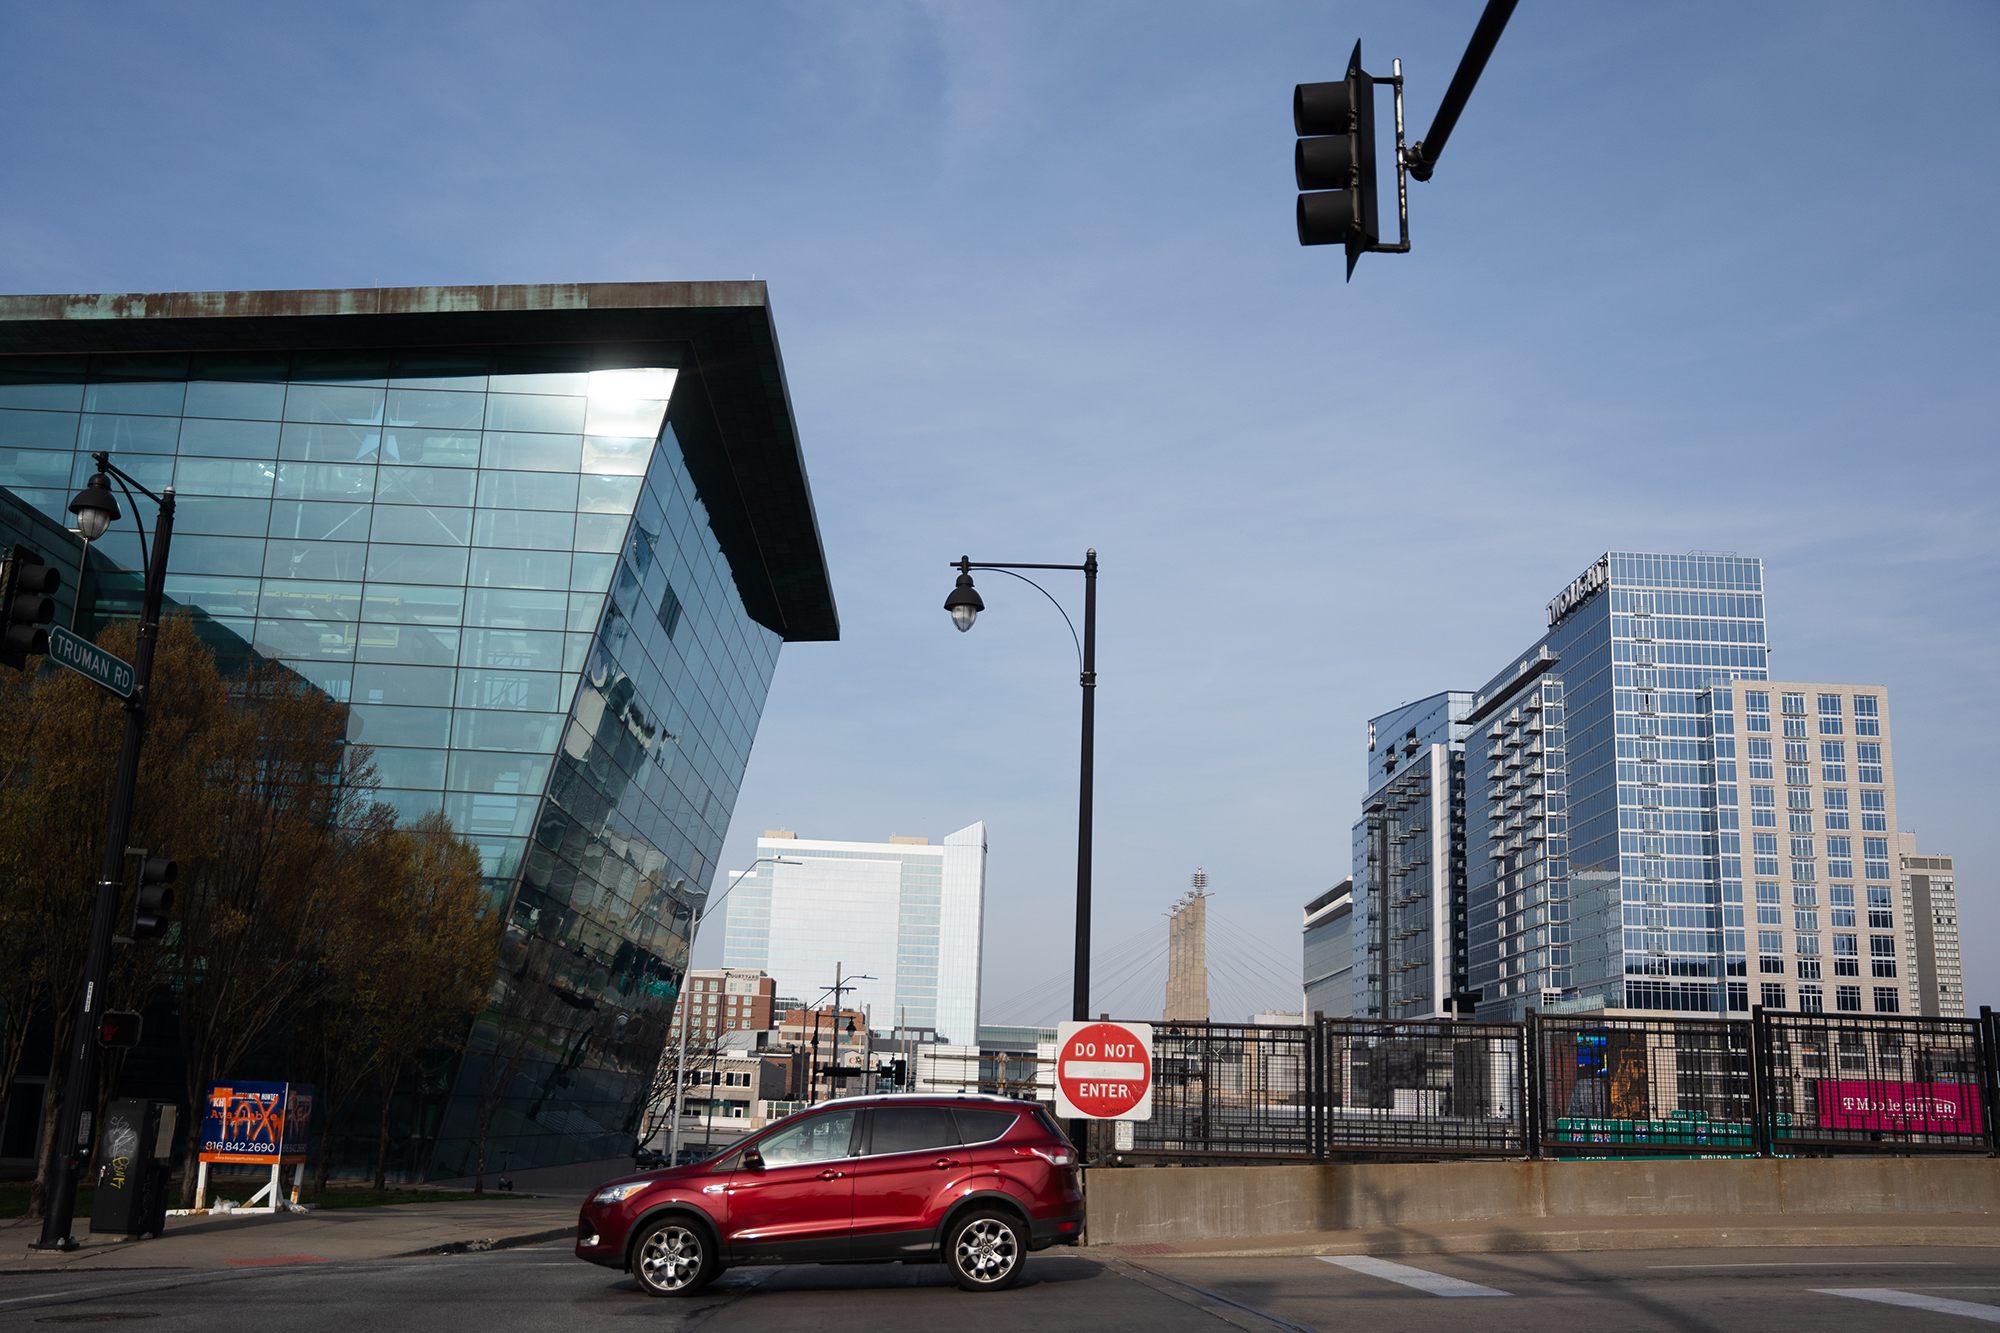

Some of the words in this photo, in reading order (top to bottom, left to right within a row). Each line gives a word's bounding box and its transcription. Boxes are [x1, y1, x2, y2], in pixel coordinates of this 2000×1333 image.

[57, 634, 110, 679] TRUMAN
[113, 665, 130, 688] RD
[1075, 1043, 1096, 1057] DO
[1104, 1043, 1135, 1058] NOT
[1080, 1083, 1128, 1098] ENTER
[1856, 1097, 1901, 1111] Moble
[208, 1092, 280, 1143] TAX
[210, 1110, 278, 1120] Avalbe
[205, 1141, 275, 1153] 816.842.2690
